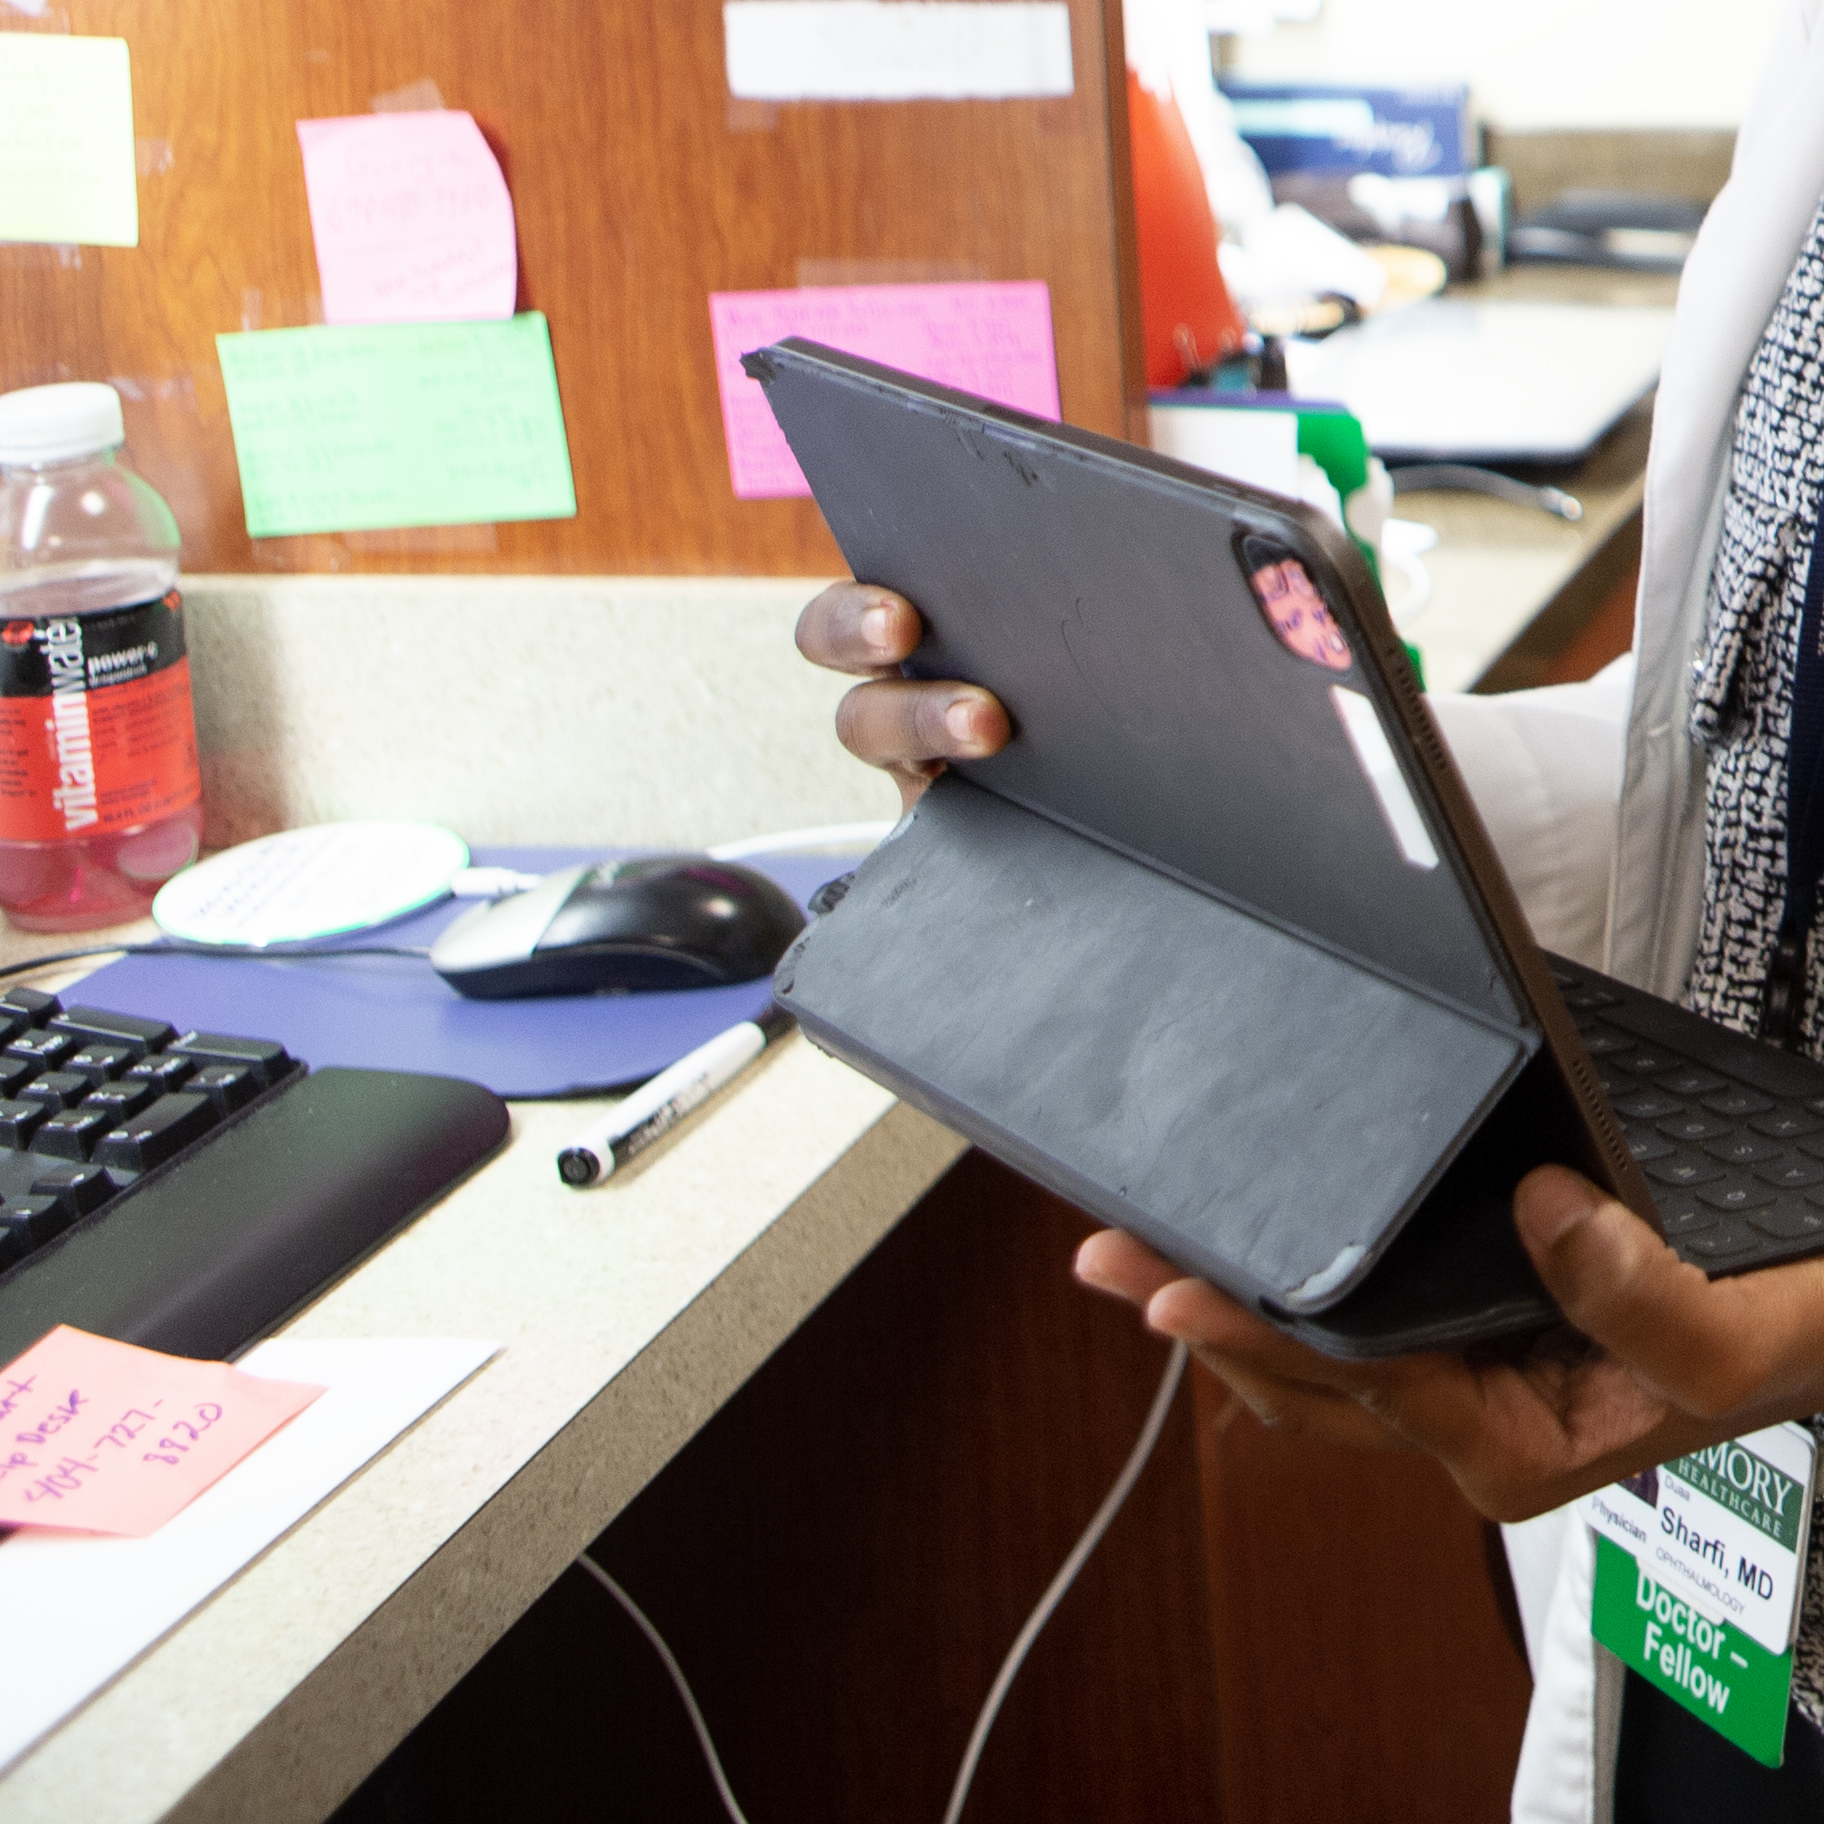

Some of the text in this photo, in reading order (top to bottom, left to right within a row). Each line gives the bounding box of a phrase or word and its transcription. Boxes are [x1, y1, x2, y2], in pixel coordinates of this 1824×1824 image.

[15, 1387, 90, 1445] Desk
[1677, 1457, 1784, 1540] HEALTHCARE
[1688, 1440, 1794, 1518] MORY
[1591, 1495, 1648, 1544] Physician
[1660, 1505, 1775, 1601] Sharfi, MD
[1635, 1575, 1727, 1662] Doctor
[1655, 1546, 1745, 1616] OPHTHALMOLOGY
[1642, 1619, 1731, 1715] Fellow
